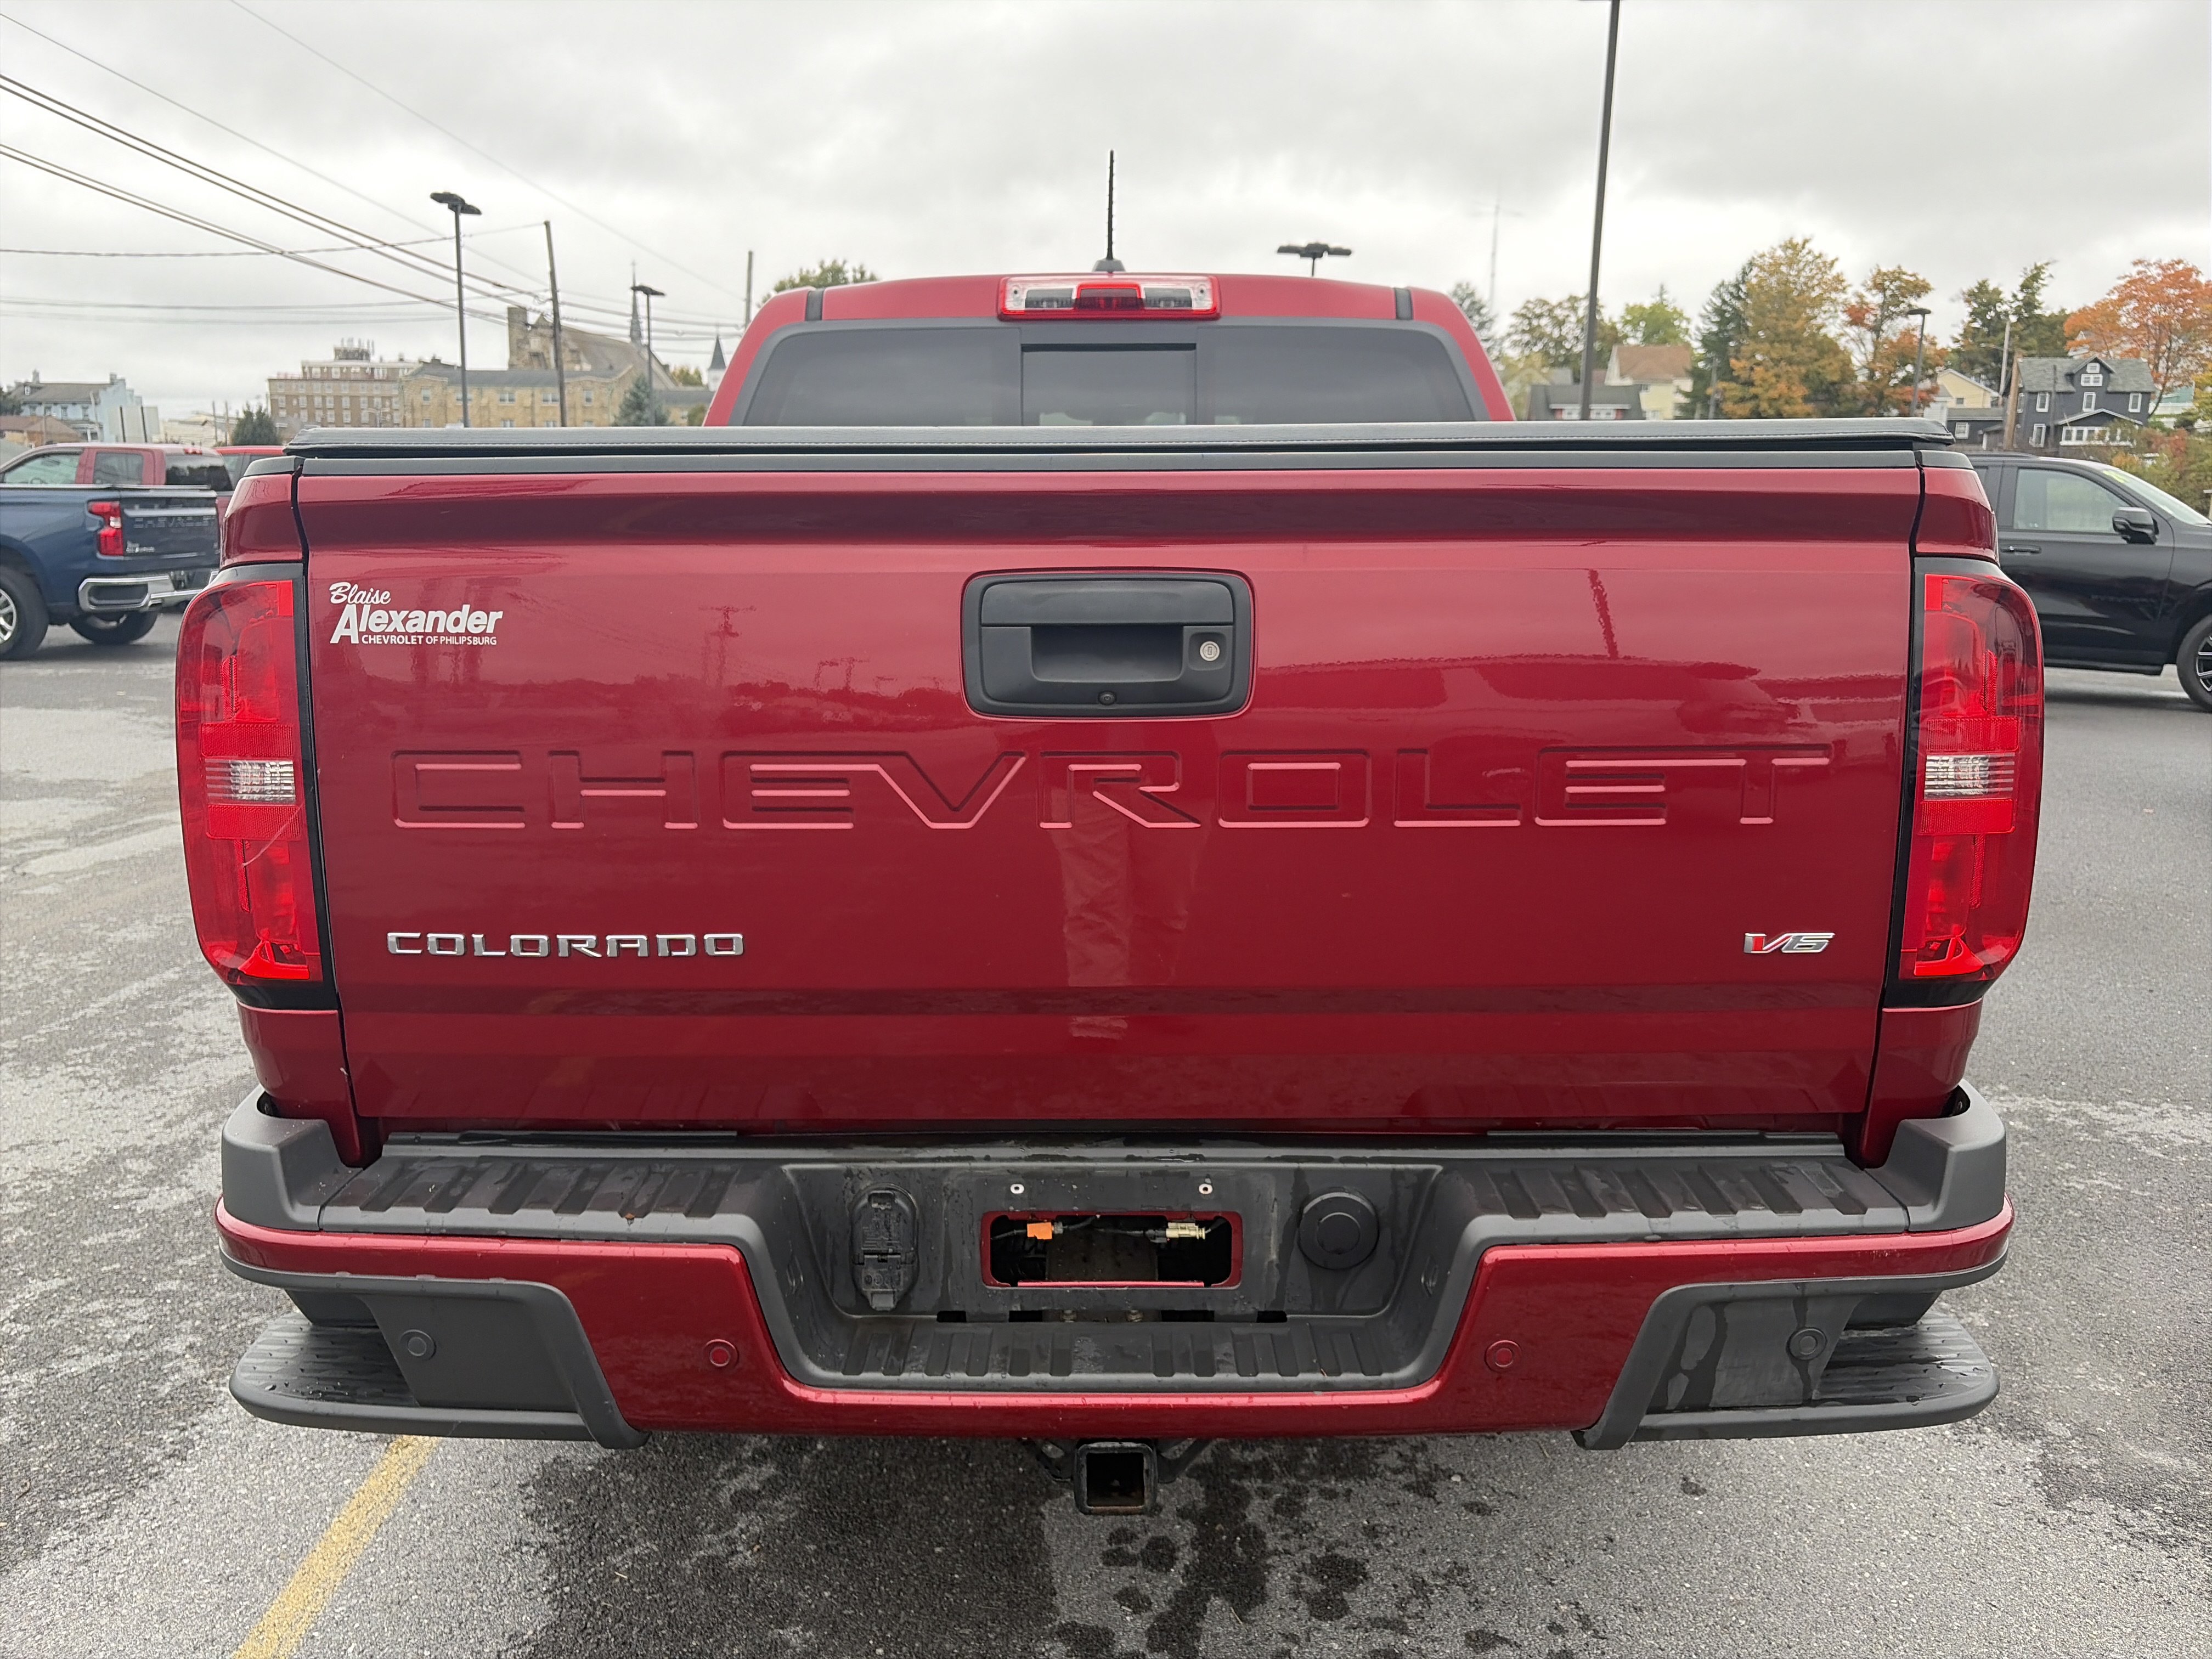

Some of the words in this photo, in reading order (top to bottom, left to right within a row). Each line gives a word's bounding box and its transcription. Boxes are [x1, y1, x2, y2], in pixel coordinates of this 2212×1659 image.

[329, 582, 391, 604] Blaise
[330, 604, 503, 644] Alexander
[362, 634, 424, 645] CHEVROLET
[426, 636, 438, 645] OF
[440, 636, 497, 645] PHILIPSBURG
[392, 744, 1831, 830] CHEVROLET
[387, 932, 744, 958] COLORADO
[1743, 932, 1836, 953] V6
